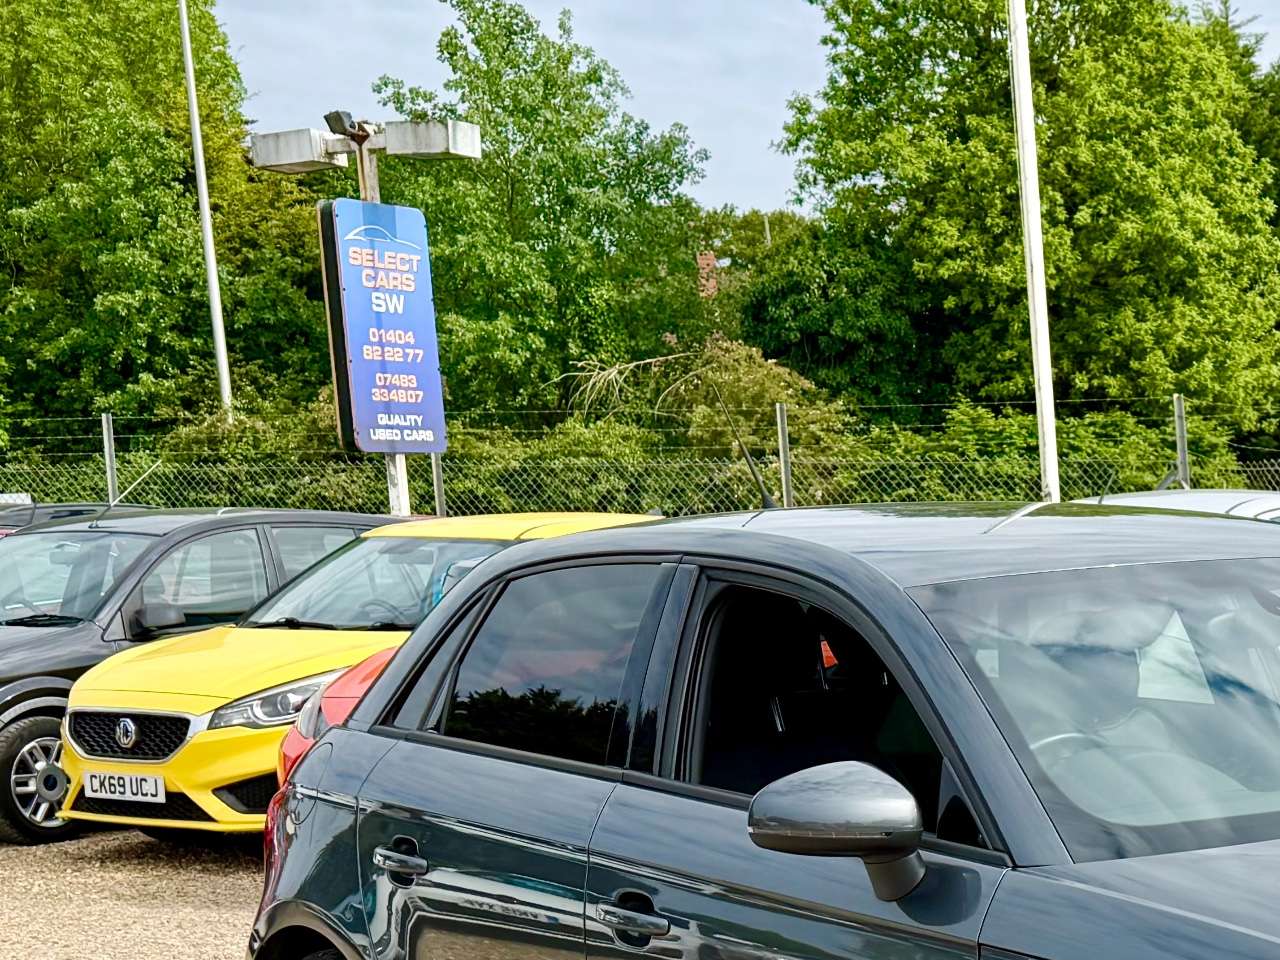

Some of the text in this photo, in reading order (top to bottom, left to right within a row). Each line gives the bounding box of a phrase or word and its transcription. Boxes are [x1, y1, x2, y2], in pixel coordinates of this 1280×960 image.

[348, 246, 421, 273] SELECT
[361, 269, 416, 293] CARS
[371, 291, 405, 315] SW
[369, 327, 415, 345] 01404
[376, 413, 424, 427] QUALITY
[370, 428, 435, 442] USED CARS
[89, 774, 158, 798] CK69 UCJ
